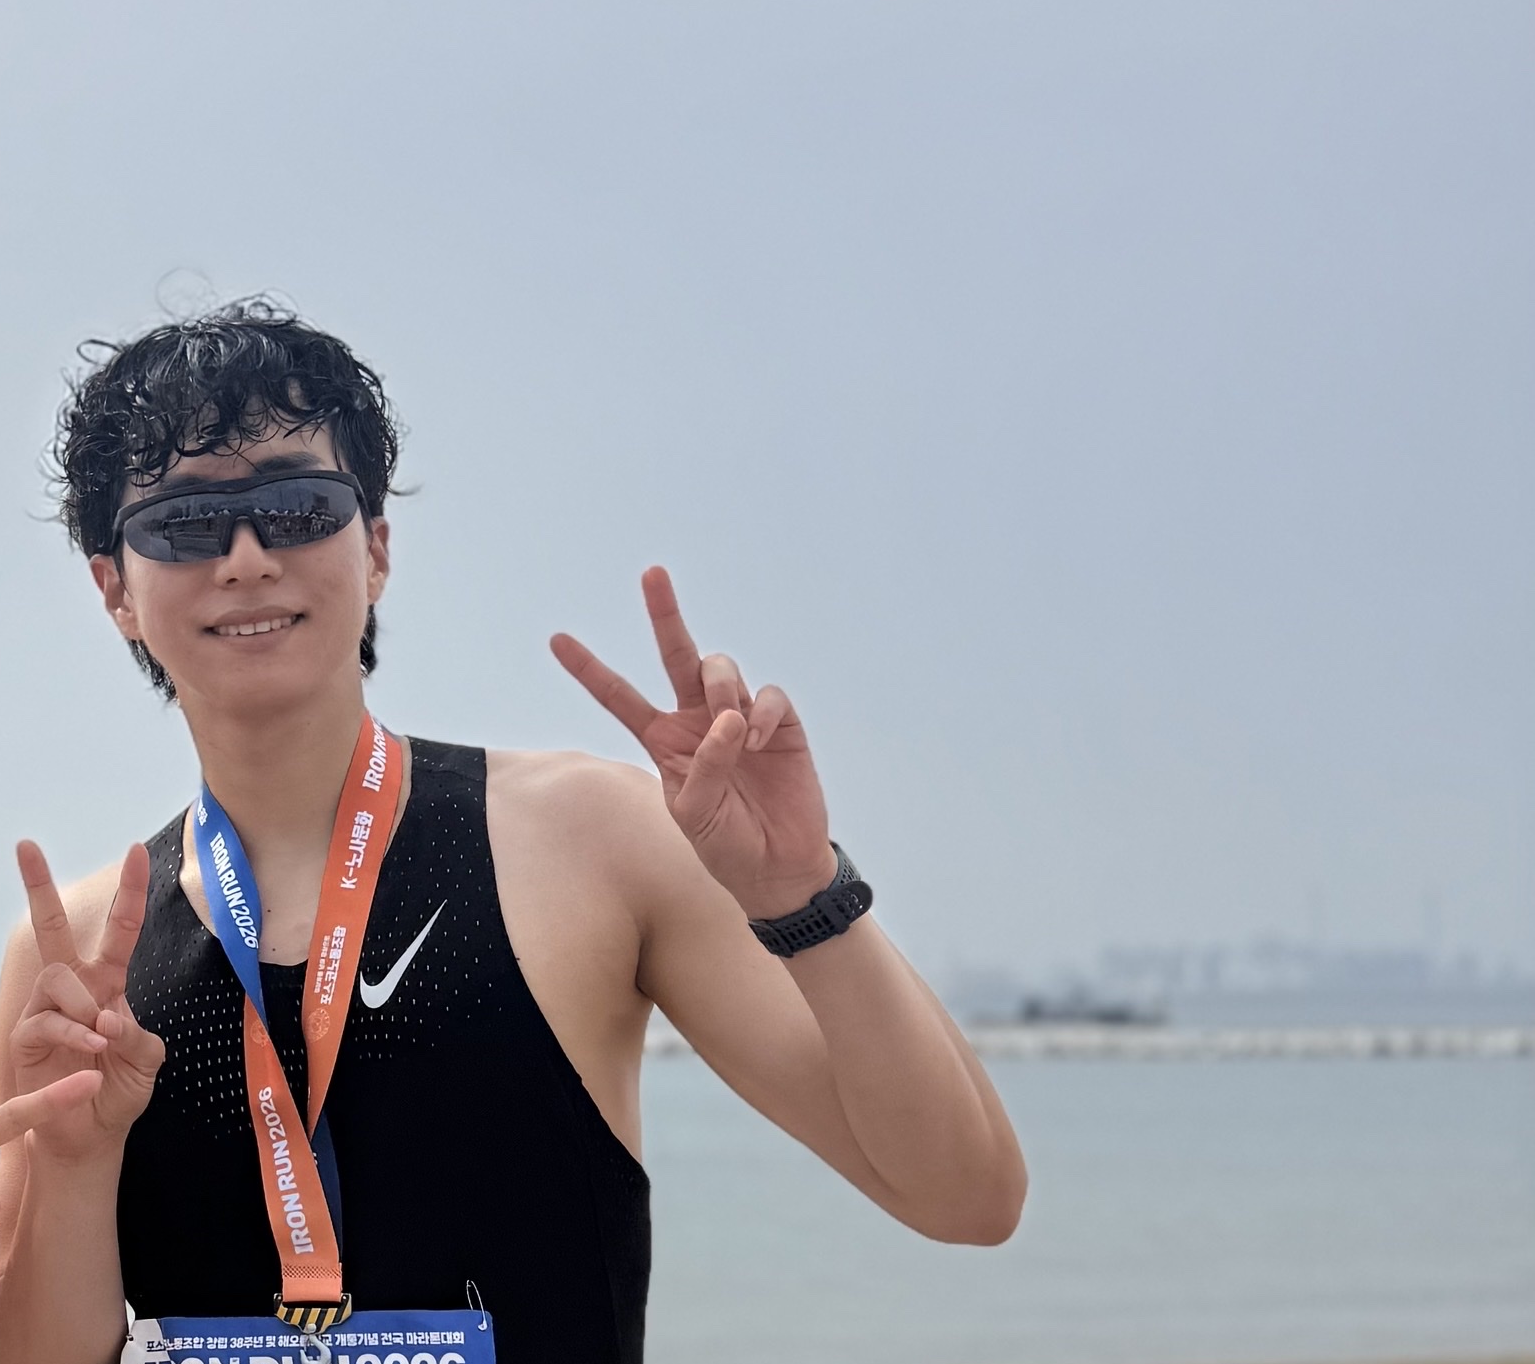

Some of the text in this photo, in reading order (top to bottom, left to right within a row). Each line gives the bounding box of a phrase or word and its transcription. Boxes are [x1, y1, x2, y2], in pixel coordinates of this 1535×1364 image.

[210, 831, 259, 949] IRON RUN 2026
[259, 1086, 314, 1254] IRON RUN 2026
[146, 1337, 204, 1352] 포스코노동조합
[206, 1337, 228, 1349] 창립
[229, 1336, 263, 1349] 38주년
[278, 1334, 332, 1348] 해오교
